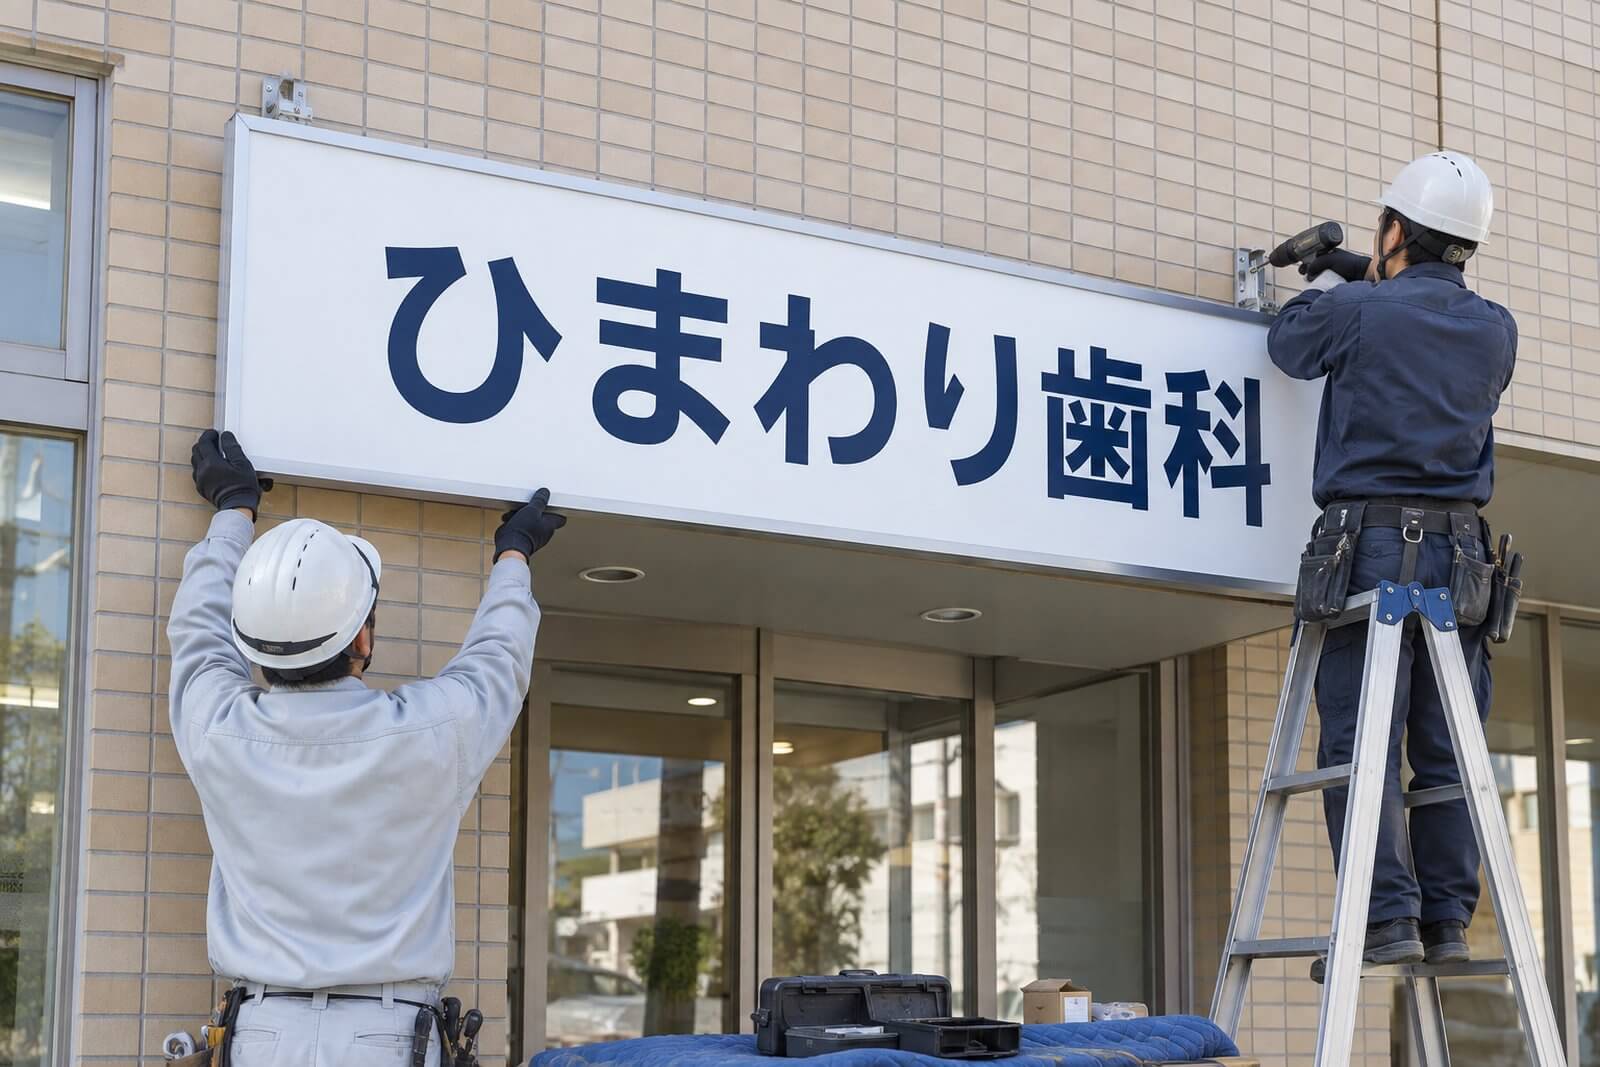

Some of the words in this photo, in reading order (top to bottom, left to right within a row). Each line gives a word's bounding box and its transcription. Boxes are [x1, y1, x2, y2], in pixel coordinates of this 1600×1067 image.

[384, 246, 1272, 528] ひまわり歯科
